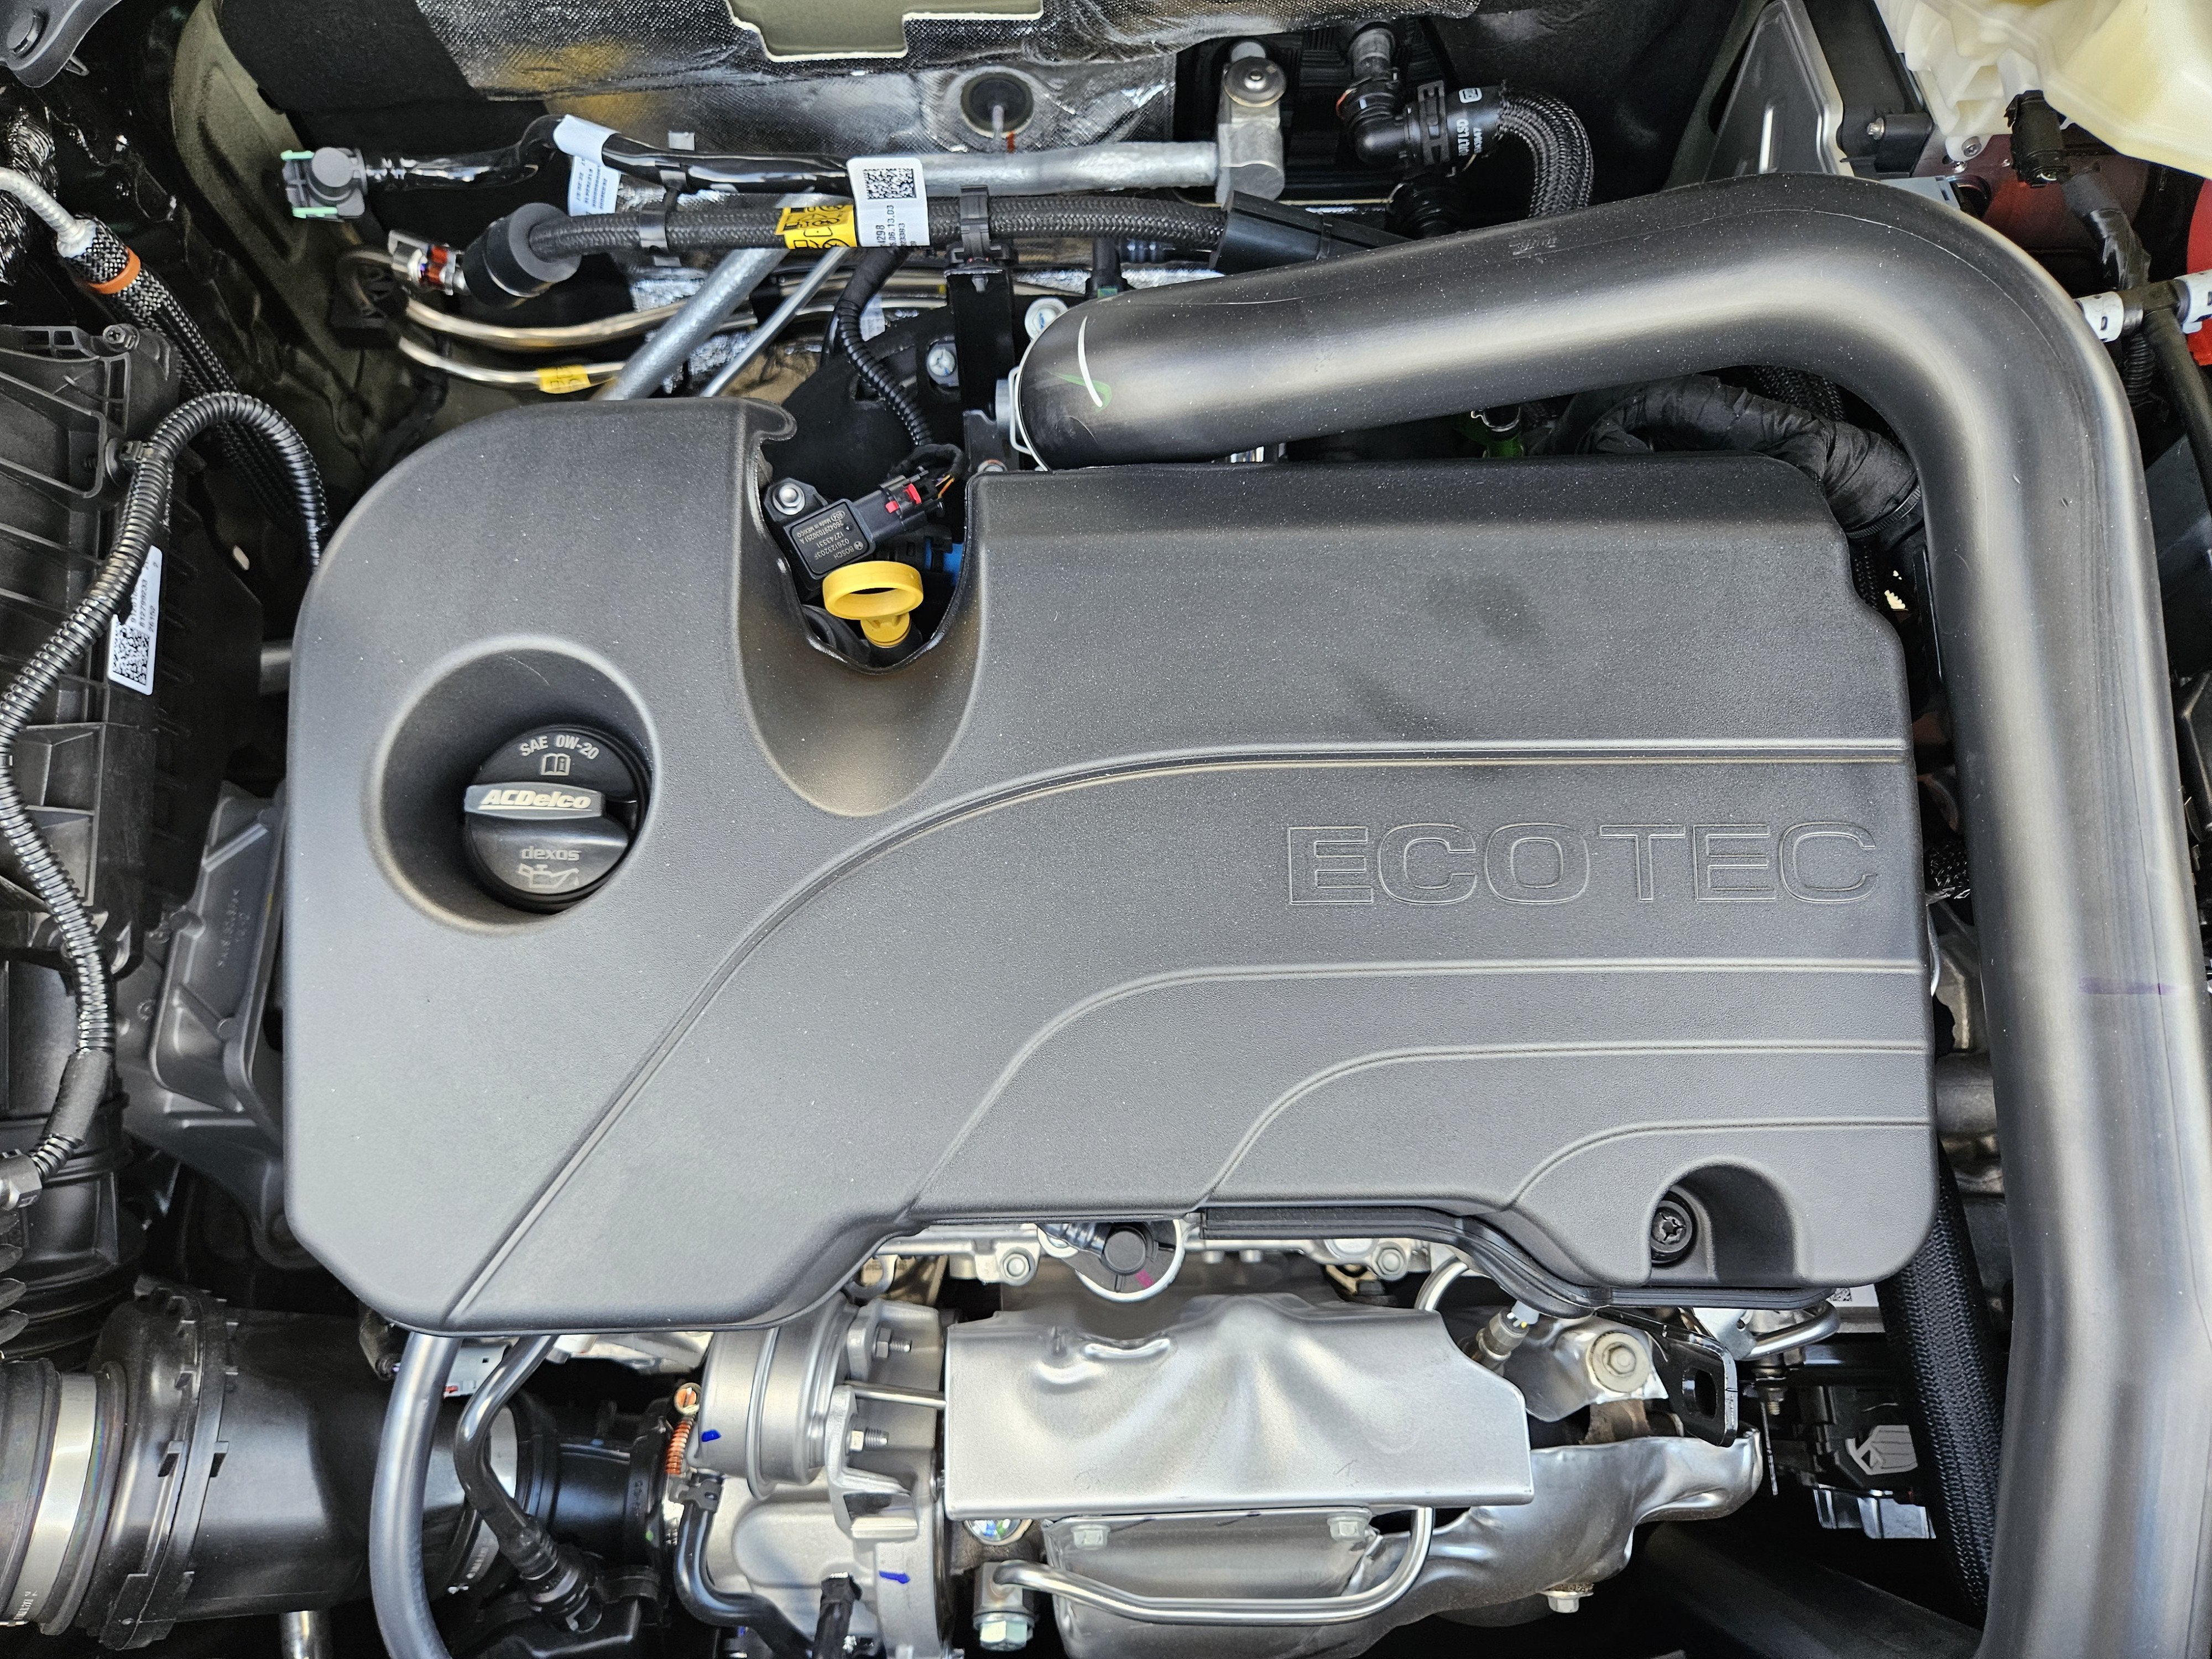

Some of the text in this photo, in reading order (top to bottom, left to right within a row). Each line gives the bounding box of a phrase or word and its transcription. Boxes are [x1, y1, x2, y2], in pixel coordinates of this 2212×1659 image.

[819, 518, 832, 526] Made
[797, 526, 815, 538] MEXICO
[833, 546, 854, 560] BOSCH
[519, 734, 600, 760] SAE 0W-20
[479, 789, 592, 809] ACDelco
[521, 846, 581, 861] dexos
[1287, 822, 1877, 905] ECOTEC
